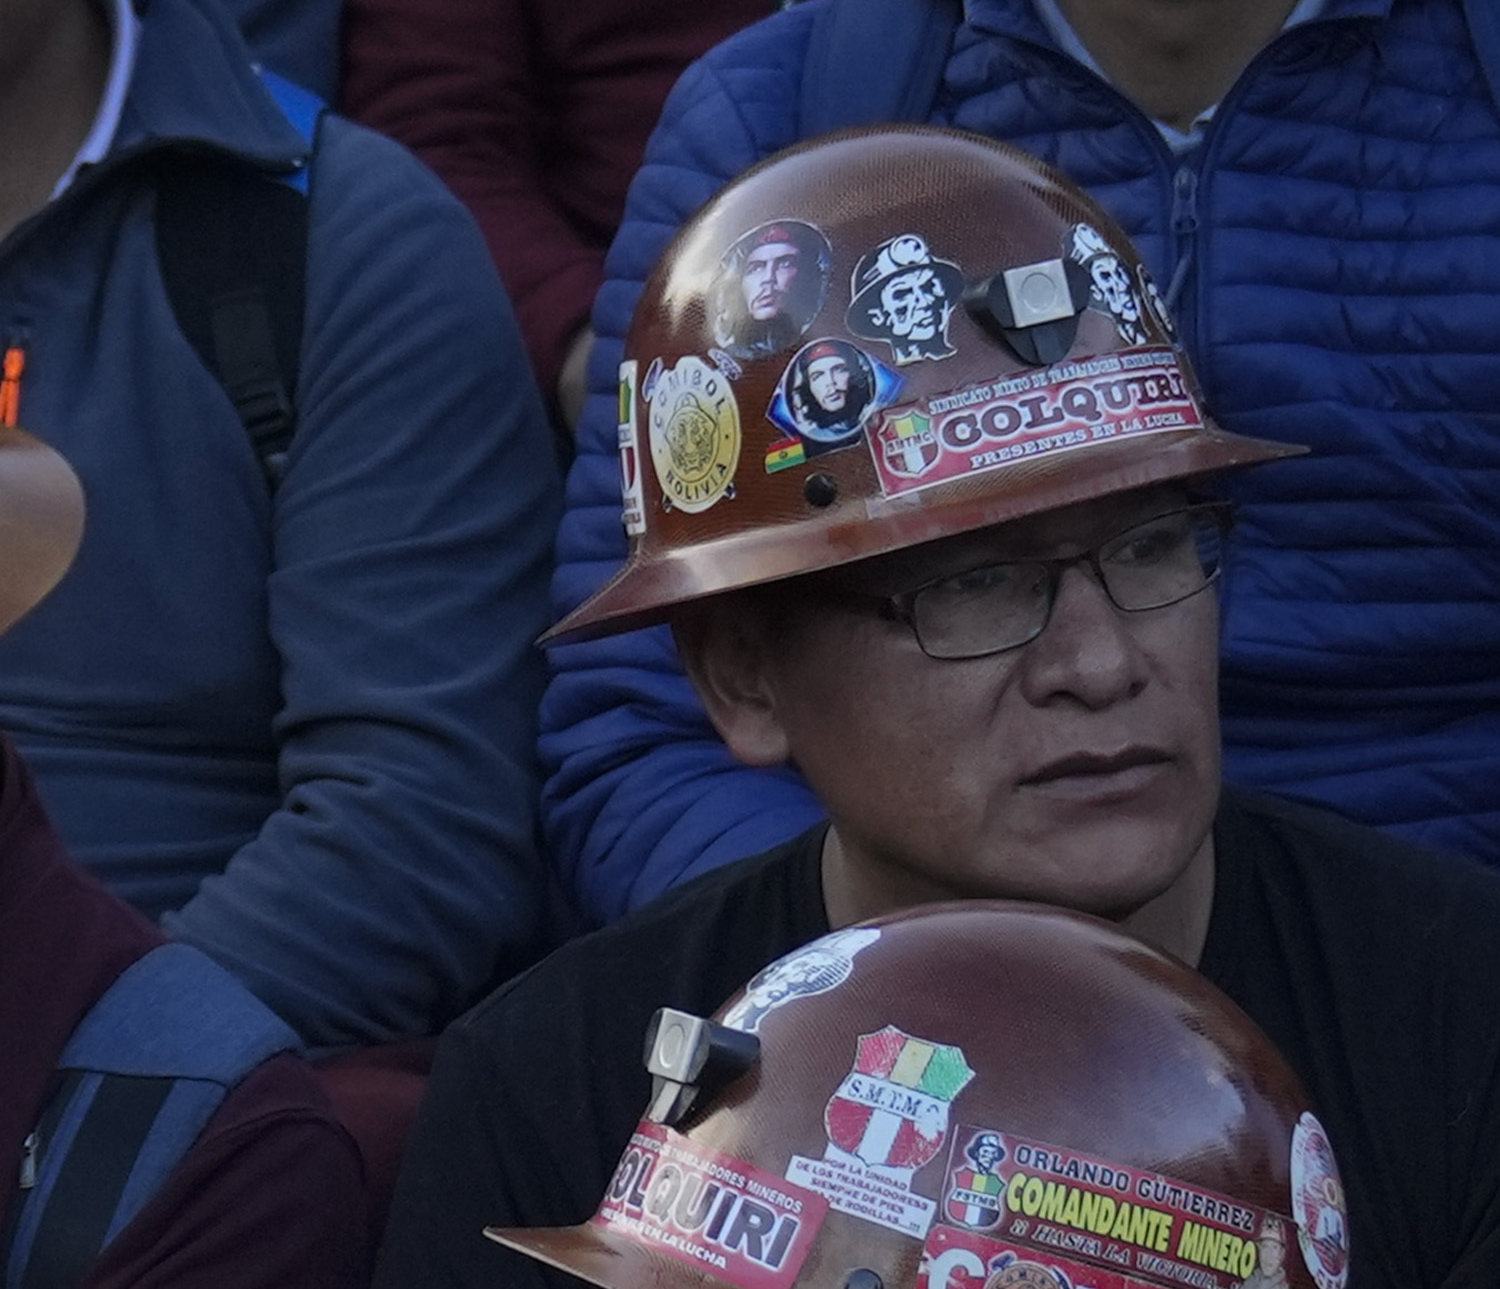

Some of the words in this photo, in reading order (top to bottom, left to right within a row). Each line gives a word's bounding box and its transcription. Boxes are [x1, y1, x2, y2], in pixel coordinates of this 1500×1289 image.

[652, 368, 728, 429] COMIBOL
[941, 372, 1191, 451] COLQUIRI
[969, 429, 1087, 470] PRESENTES
[1091, 419, 1116, 439] EN
[1119, 416, 1144, 435] LA
[665, 462, 728, 500] BOLIVIA
[1016, 1144, 1130, 1193] ORLANDO
[745, 1178, 804, 1215] MINEROS
[1005, 1172, 1174, 1254] COMANDANTE
[1177, 1220, 1258, 1281] MINERO
[1032, 1226, 1104, 1258] HASTA
[1104, 1241, 1131, 1265] LA
[678, 1238, 727, 1270] LUCHA
